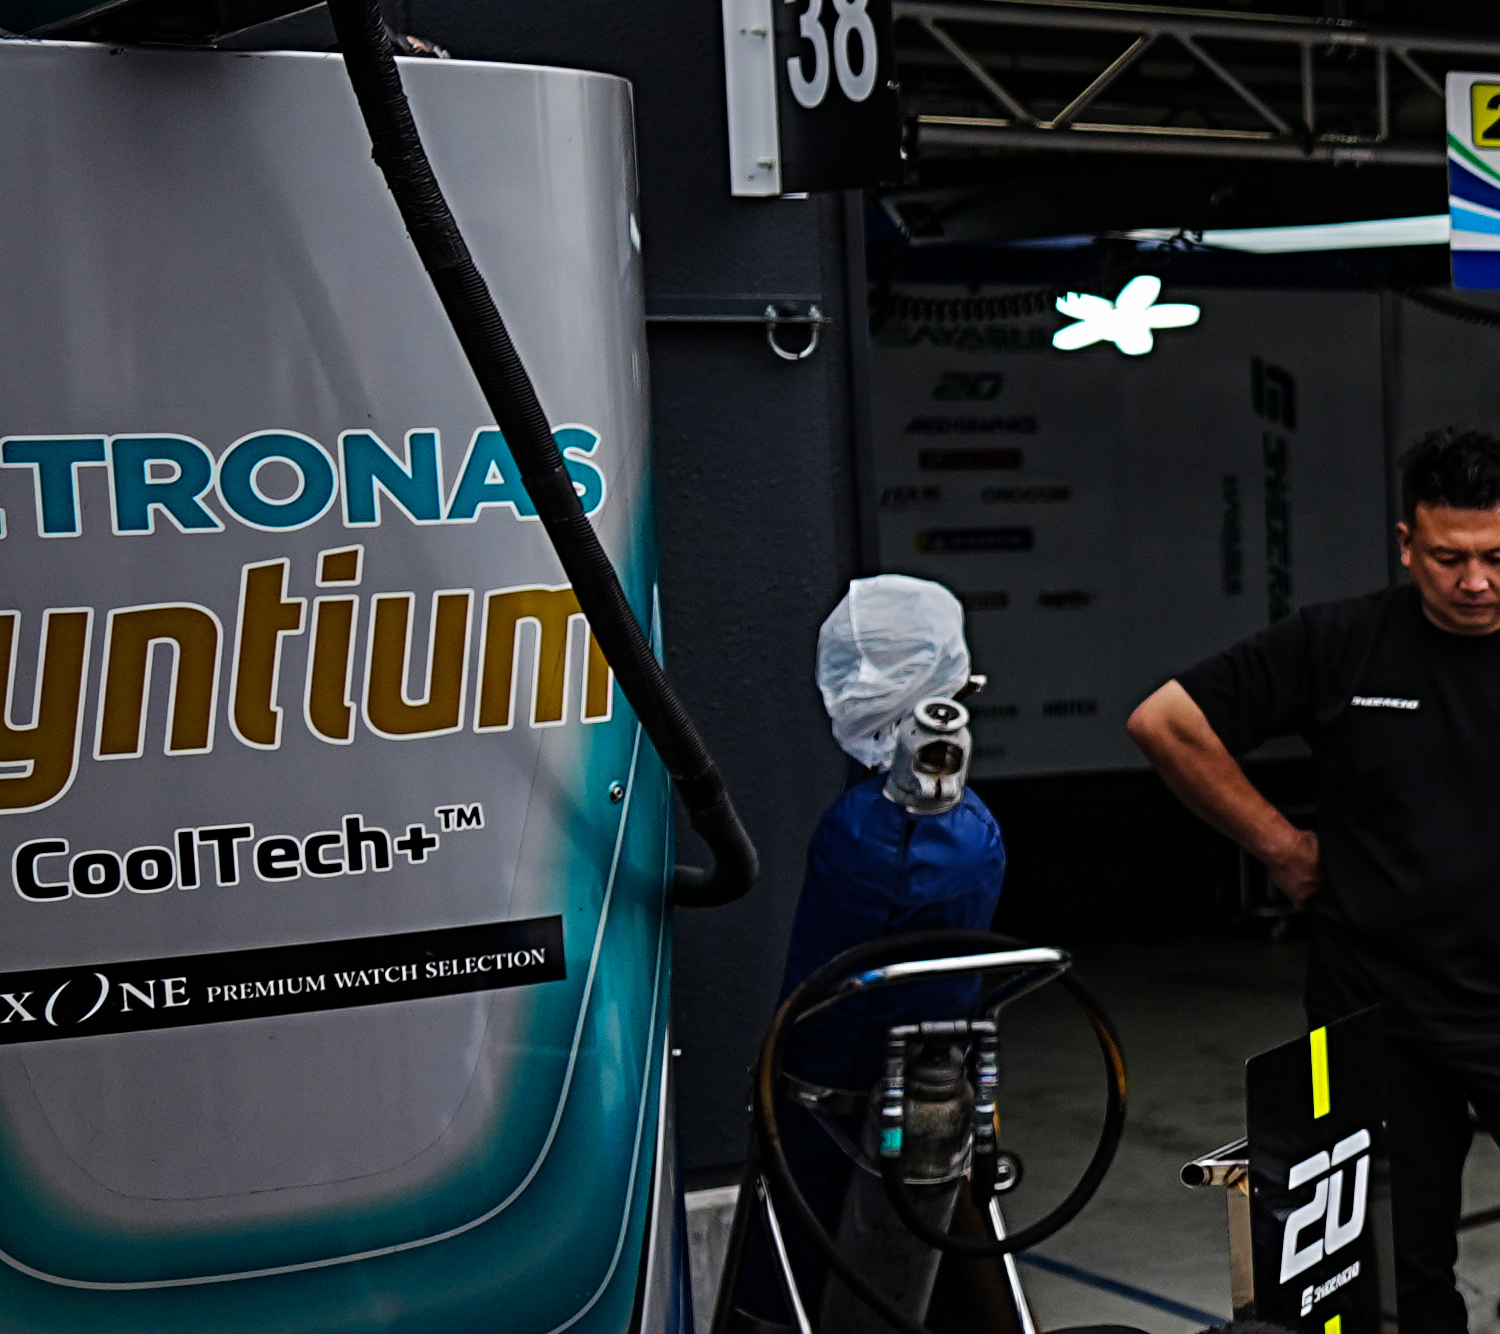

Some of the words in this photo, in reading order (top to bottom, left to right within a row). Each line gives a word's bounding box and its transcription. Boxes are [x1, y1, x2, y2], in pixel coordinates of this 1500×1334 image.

[932, 372, 1001, 400] 20
[0, 424, 607, 539] TRONAS
[206, 976, 327, 1003] PREMIUM
[333, 964, 418, 989] WATCH
[425, 948, 547, 979] SELECTION
[1279, 1128, 1371, 1285] 20
